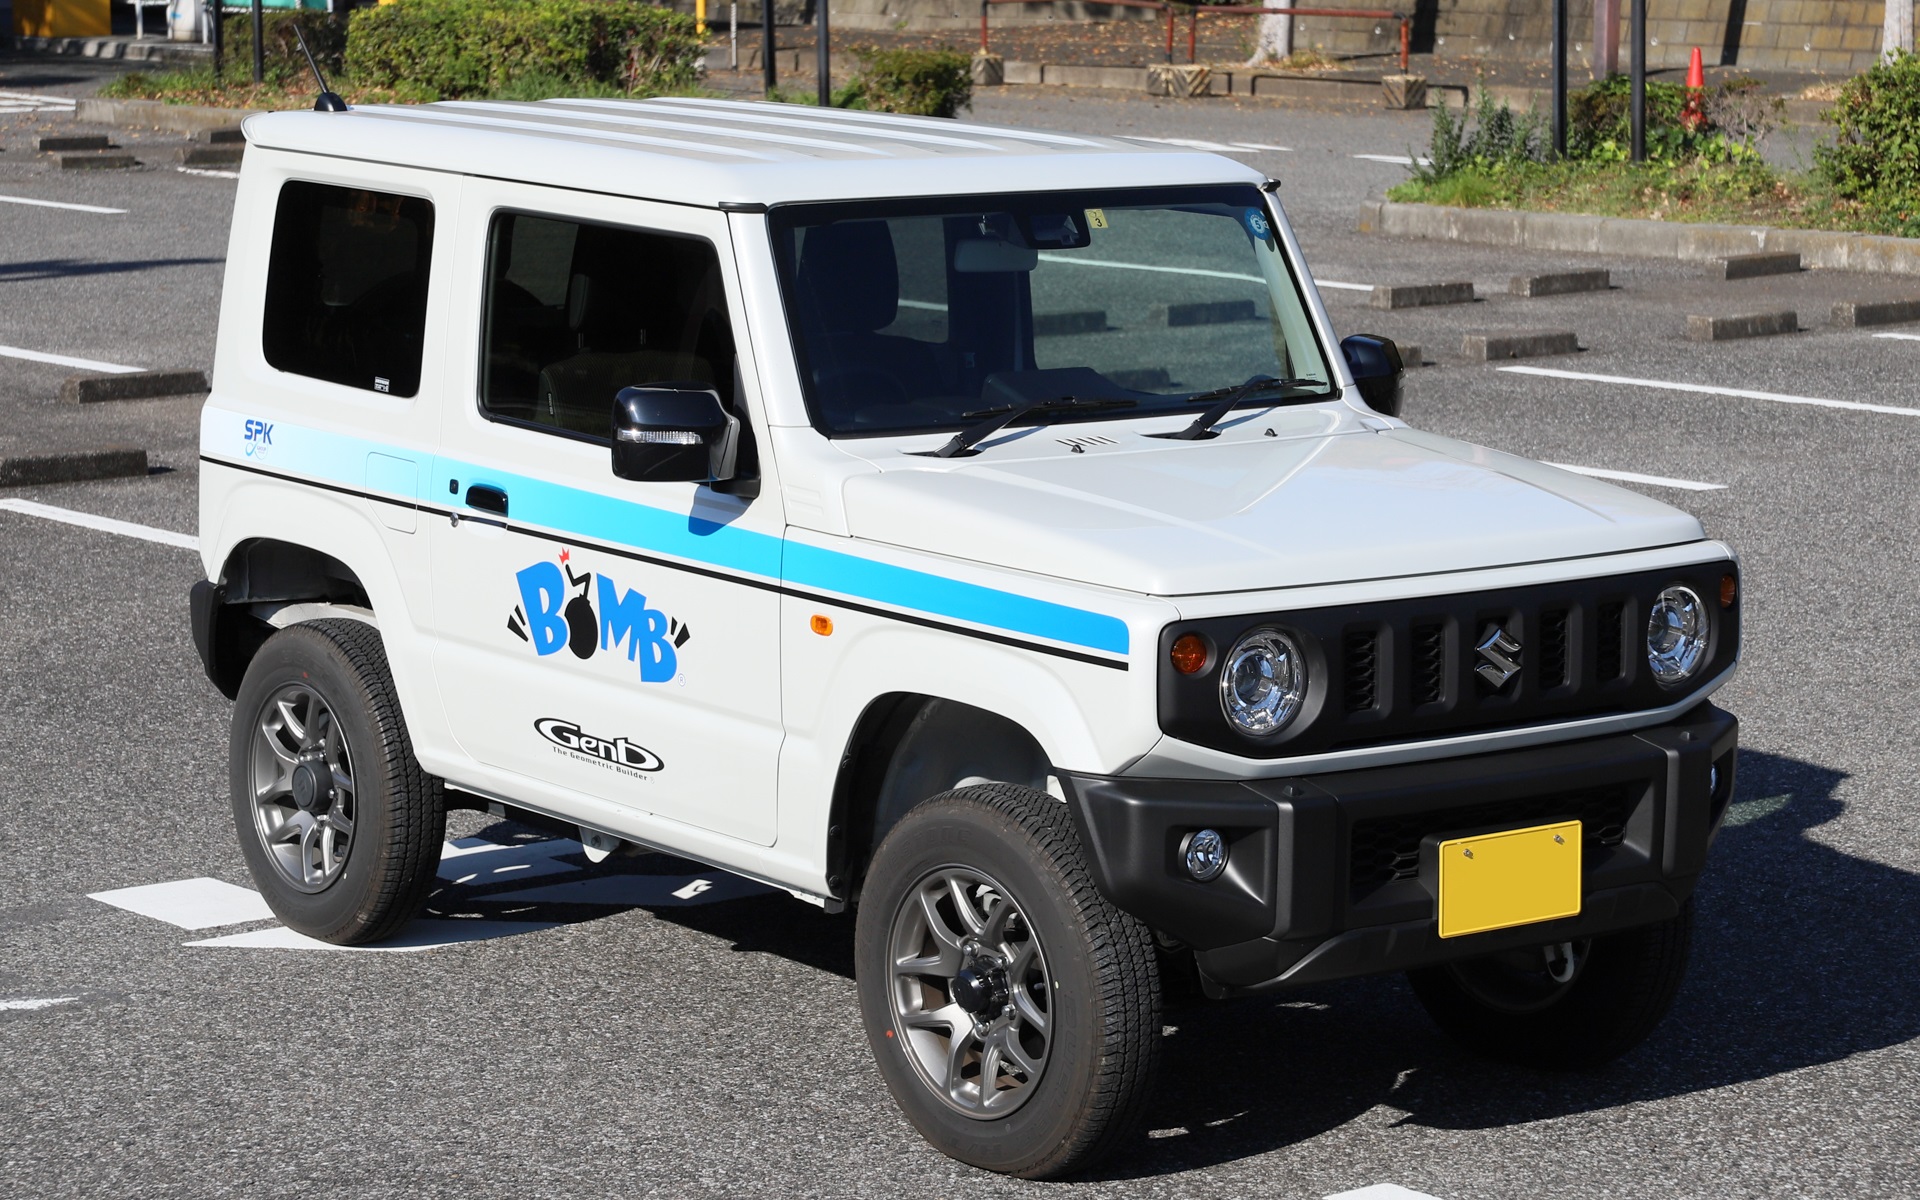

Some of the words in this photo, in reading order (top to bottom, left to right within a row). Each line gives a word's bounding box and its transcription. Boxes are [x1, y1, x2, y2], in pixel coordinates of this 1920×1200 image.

[1094, 217, 1103, 228] 3
[244, 419, 274, 445] SPK
[516, 561, 677, 683] BOMB
[552, 745, 568, 757] The
[570, 751, 614, 771] Geometric
[616, 766, 648, 781] Builder
